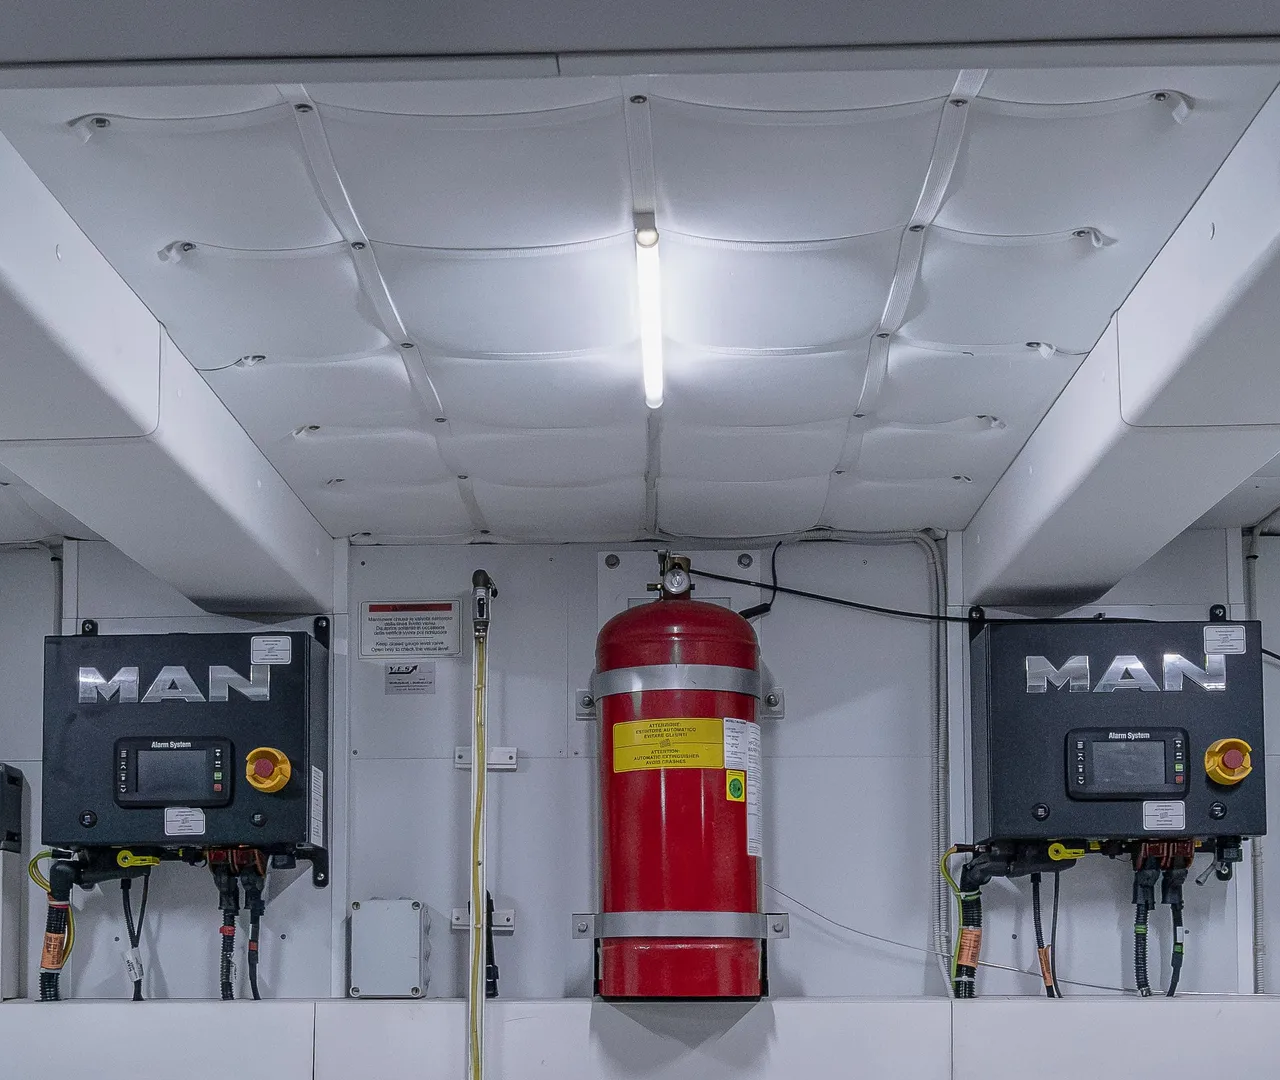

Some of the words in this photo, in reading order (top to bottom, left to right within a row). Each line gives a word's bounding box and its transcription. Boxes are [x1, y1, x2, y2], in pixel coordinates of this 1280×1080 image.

[78, 665, 270, 703] MAN
[1025, 653, 1226, 693] MAN
[170, 741, 192, 749] System
[1127, 732, 1150, 740] System
